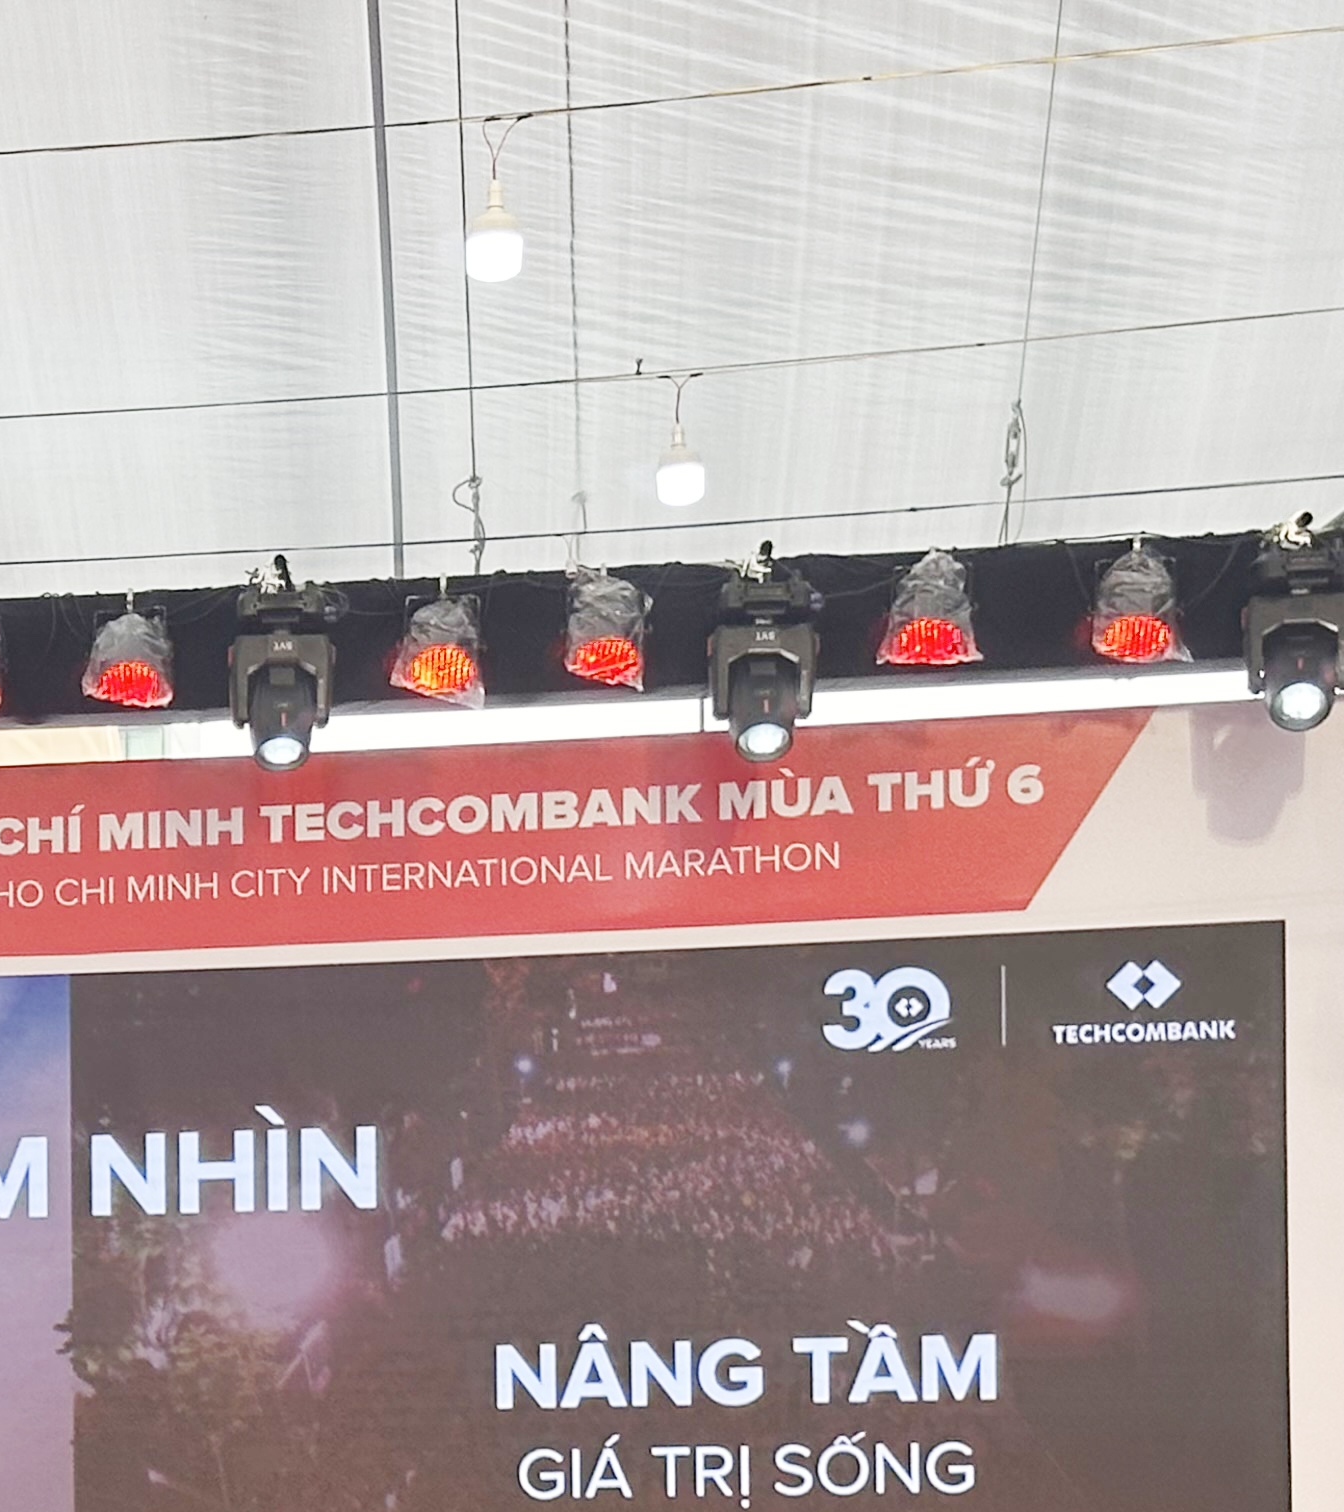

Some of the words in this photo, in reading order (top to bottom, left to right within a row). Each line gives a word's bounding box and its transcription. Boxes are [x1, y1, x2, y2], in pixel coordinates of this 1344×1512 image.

[98, 806, 245, 851] MINH
[259, 783, 704, 844] TECHCOMBANK
[718, 767, 854, 821] MÙA
[867, 756, 995, 813] THỨ
[1006, 764, 1045, 806] 6
[55, 876, 115, 906] CHI
[127, 871, 219, 903] MINH
[230, 866, 312, 898] CITY
[322, 853, 612, 895] INTERNATIONAL
[624, 841, 840, 881] MARATHON
[1052, 1018, 1237, 1046] TECHCOMBANK
[90, 1104, 378, 1217] NHÌN
[494, 1322, 765, 1411] NÂNG
[792, 1318, 999, 1404] TẦM
[517, 1433, 634, 1501] GIÁ
[650, 1444, 751, 1510] TRỊ
[773, 1430, 977, 1496] SỐNG
